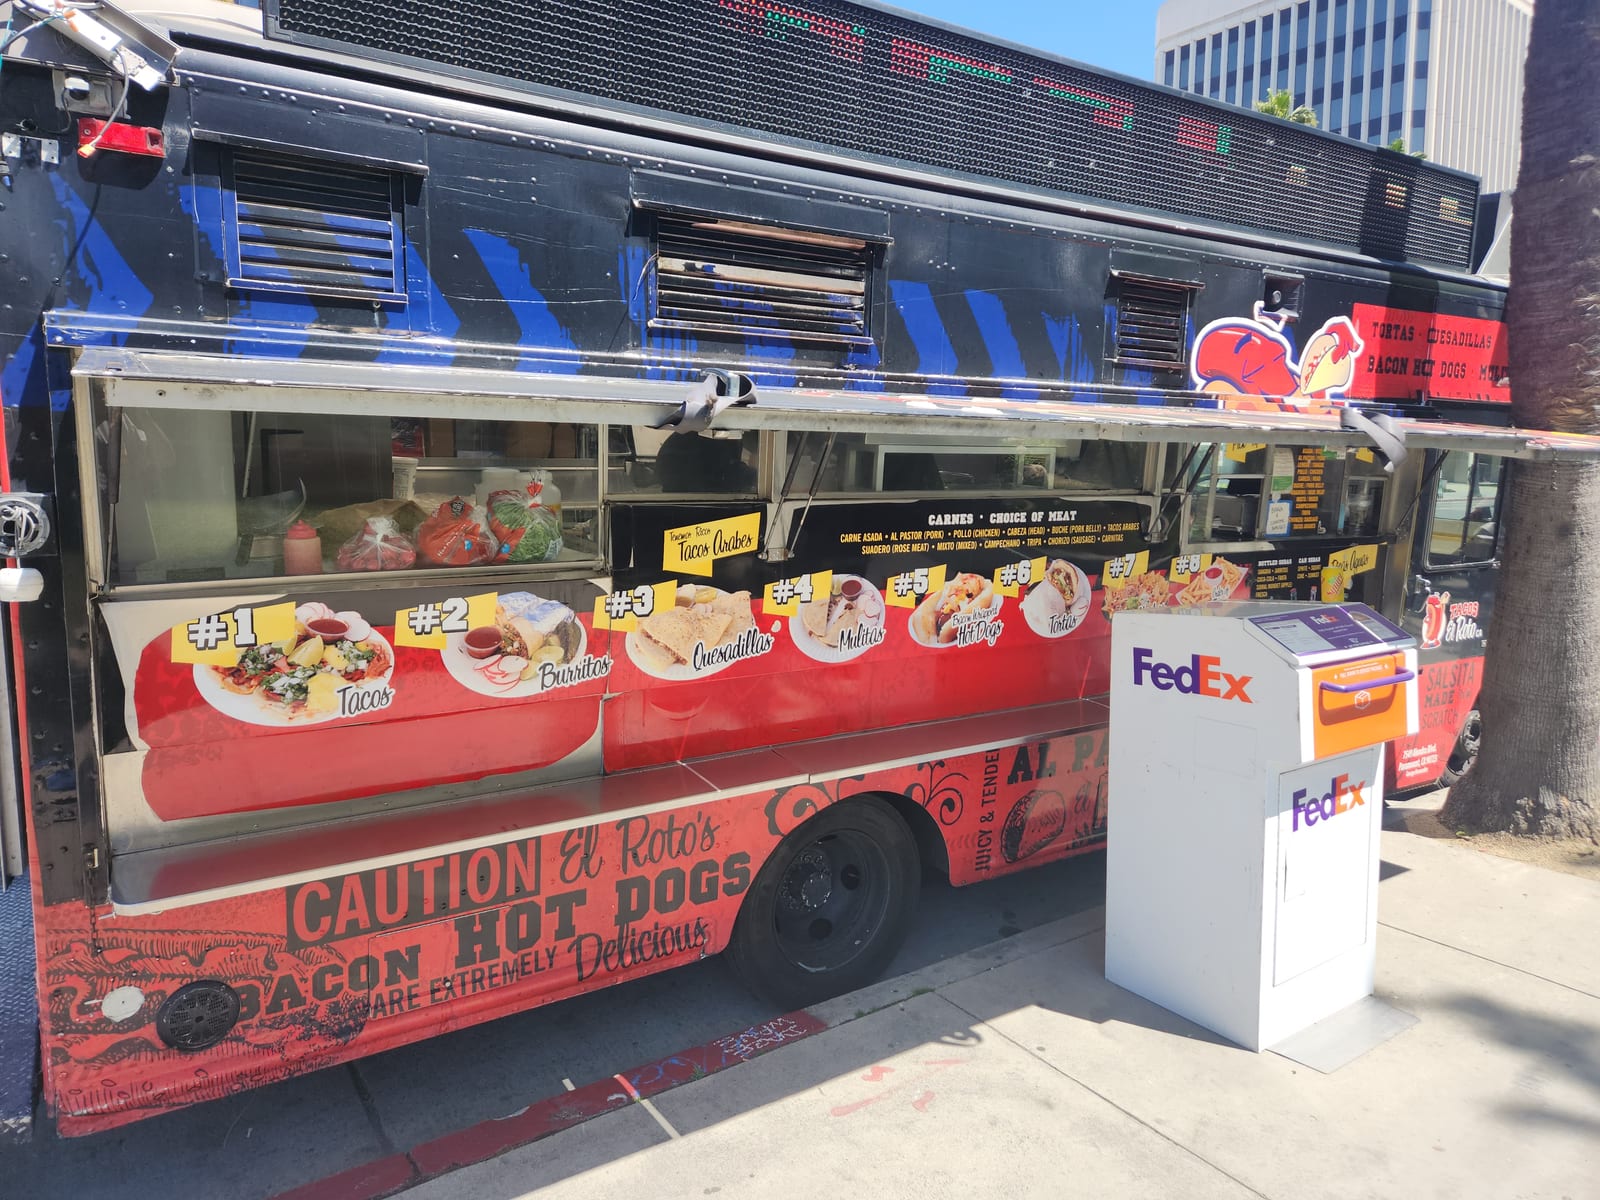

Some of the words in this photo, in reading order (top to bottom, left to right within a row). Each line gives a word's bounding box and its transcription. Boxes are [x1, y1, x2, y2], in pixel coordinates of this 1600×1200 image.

[1372, 322, 1415, 341] TORTAS
[1426, 328, 1492, 349] QUESADILLAS
[1367, 355, 1409, 375] BACON
[1412, 358, 1435, 377] HOT
[1440, 361, 1467, 379] DOGS
[928, 513, 974, 526] CARNES
[989, 511, 1027, 524] CHOICE
[1031, 511, 1044, 522] OF
[1048, 510, 1077, 522] MEAT
[678, 540, 710, 561] Tacos
[713, 529, 753, 555] Arabes
[840, 533, 861, 543] CARNE
[863, 532, 883, 542] ASADA
[890, 532, 898, 541] AL
[900, 531, 922, 541] PASTOR
[953, 529, 971, 538] POLLO
[1007, 527, 1027, 536] CABEZA
[861, 545, 891, 555] SUADERO
[892, 544, 910, 554] (ROSE
[1000, 559, 1032, 586] #6
[1109, 553, 1136, 578] #7
[772, 574, 814, 605] #4
[894, 568, 929, 597] #5
[407, 597, 469, 634] #2
[605, 584, 654, 619] #3
[1450, 601, 1480, 620] TACOS
[187, 606, 257, 650] #1
[958, 624, 975, 646] Hot
[976, 620, 1002, 646] Dogs
[1049, 613, 1077, 634] Tortas
[1310, 613, 1338, 625] FedEx
[1456, 616, 1477, 642] Roto
[693, 628, 773, 672] Quesadillas
[839, 623, 885, 652] Mulitas
[538, 654, 611, 691] Burritos
[1133, 647, 1254, 704] FedEx
[1426, 662, 1475, 692] SALSITA
[337, 684, 392, 717] Tacos
[1424, 689, 1456, 709] MADE
[1007, 742, 1056, 784] AL
[1071, 730, 1110, 773] PA
[981, 748, 1000, 807] TENDE
[980, 811, 995, 823] &
[1292, 773, 1366, 832] FedEx
[559, 824, 603, 884] El
[616, 811, 721, 874] Roto's
[975, 827, 992, 871] JUICY
[292, 841, 537, 942] CAUTION
[238, 944, 421, 1022] BACON
[454, 889, 588, 968] HOT
[614, 851, 751, 926] DOGS
[371, 984, 420, 1019] ARE
[430, 945, 558, 1004] EXTREMELY
[567, 916, 710, 982] Delicious
